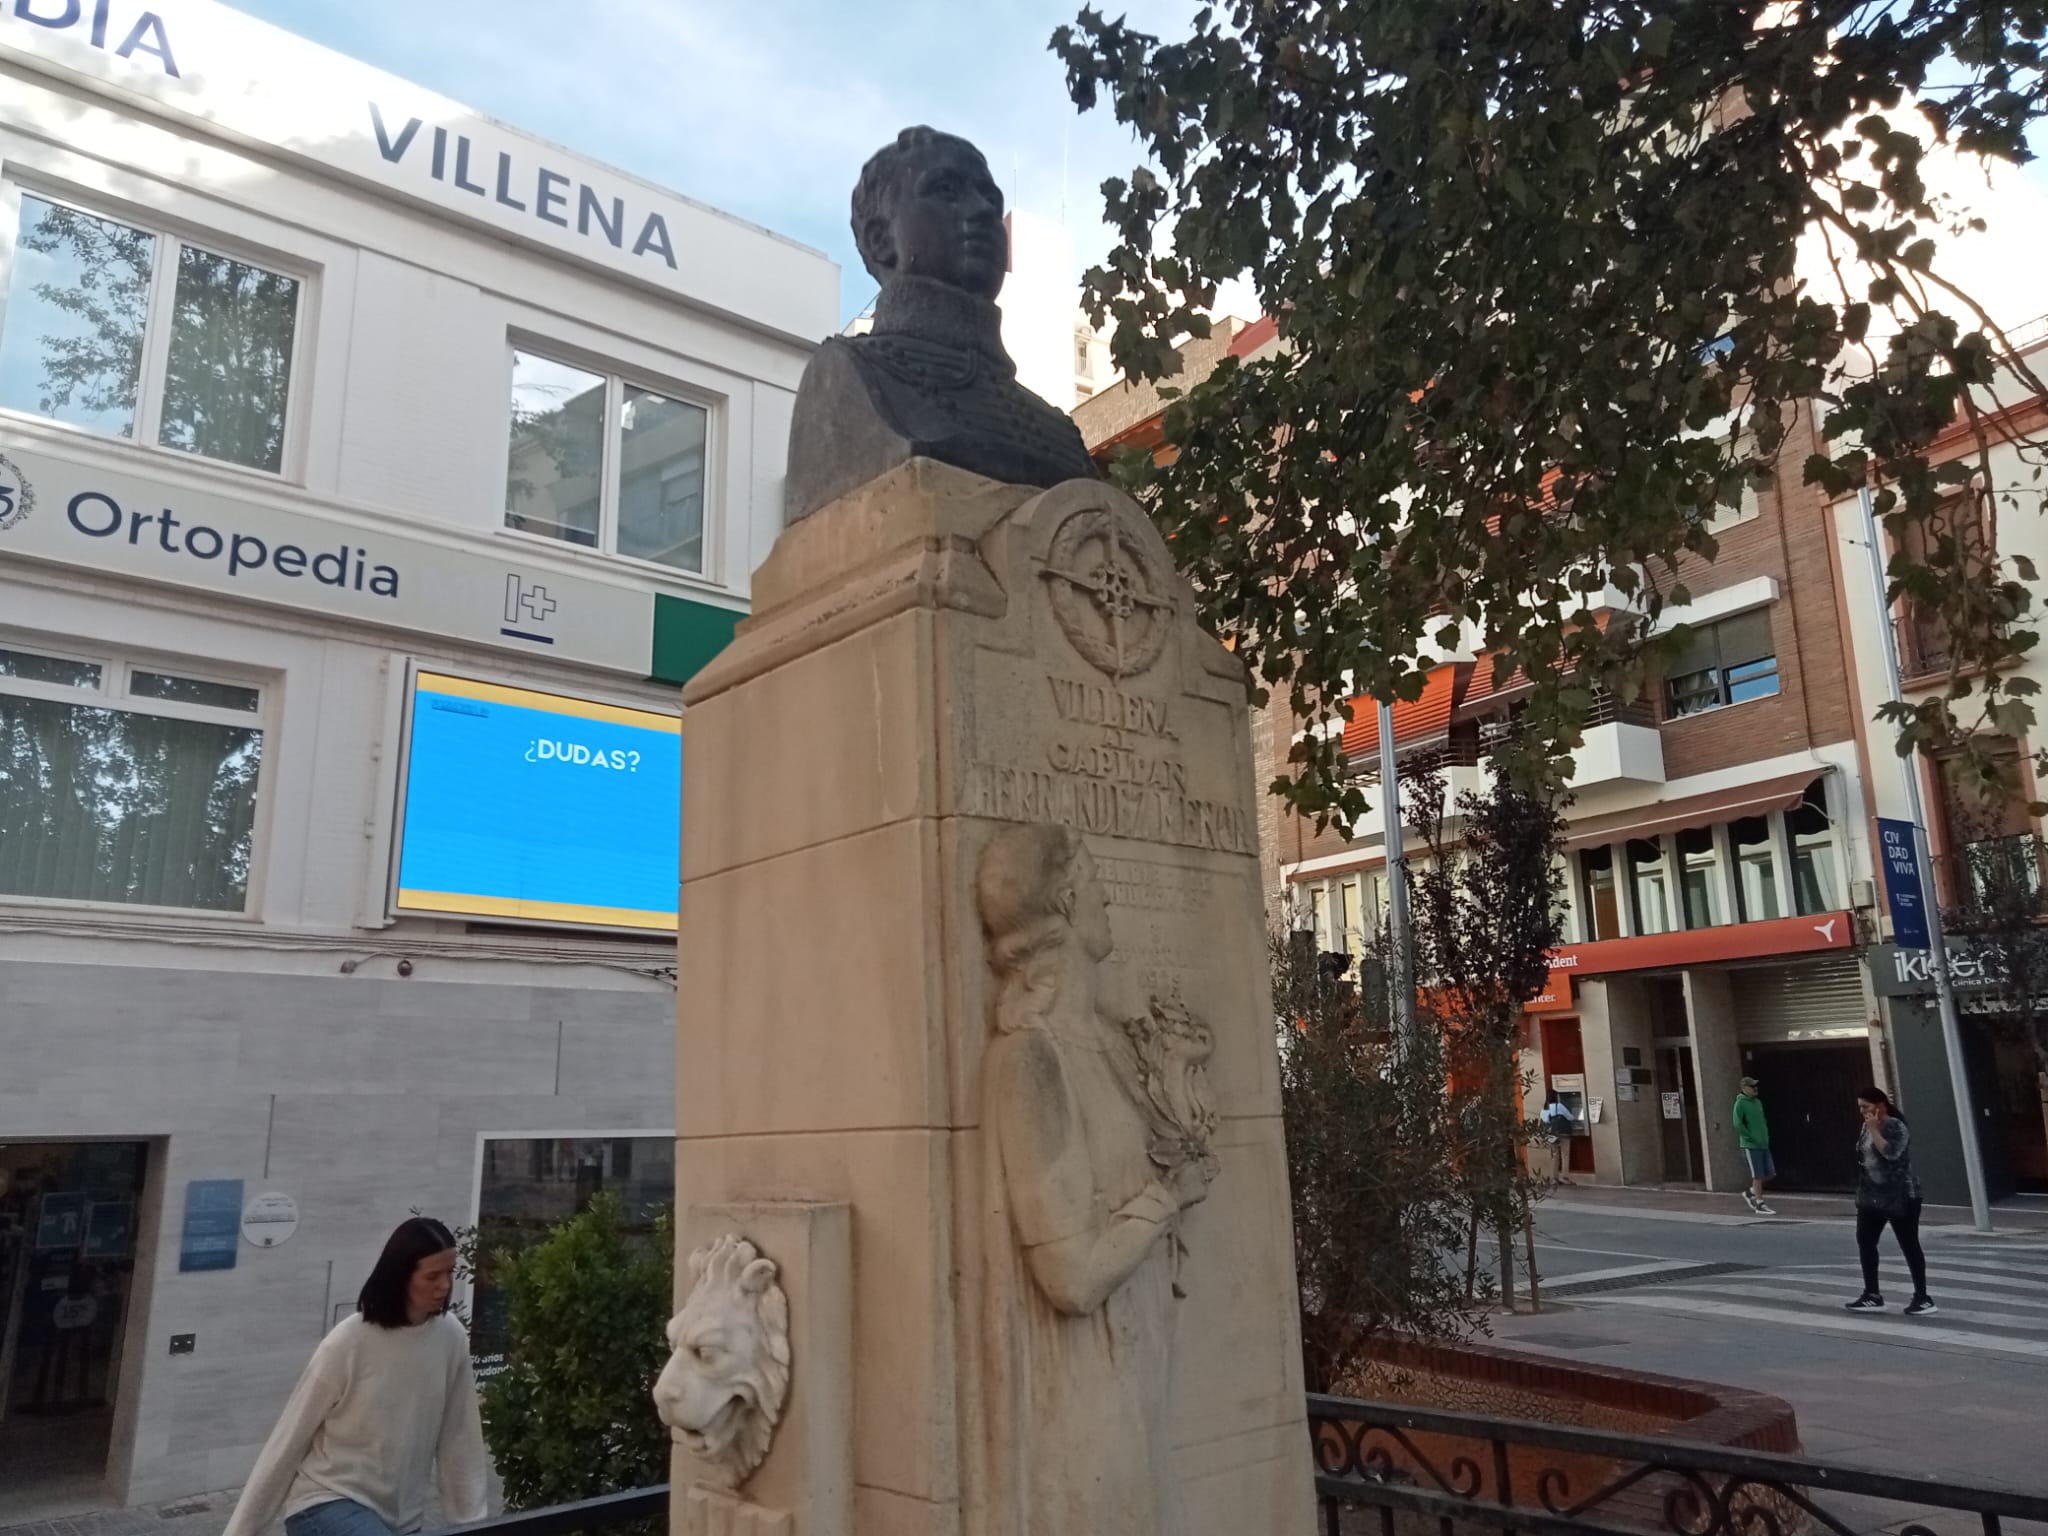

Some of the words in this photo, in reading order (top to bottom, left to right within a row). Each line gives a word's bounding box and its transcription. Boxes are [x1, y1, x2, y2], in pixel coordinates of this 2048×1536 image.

[0, 0, 181, 79] DIA
[367, 101, 679, 271] VILLENA
[66, 491, 401, 599] Ortopedia
[525, 738, 641, 773] ¿DUDAS?
[1888, 846, 1909, 860] DAD
[1893, 861, 1915, 875] VIVA
[473, 1364, 510, 1379] yudan
